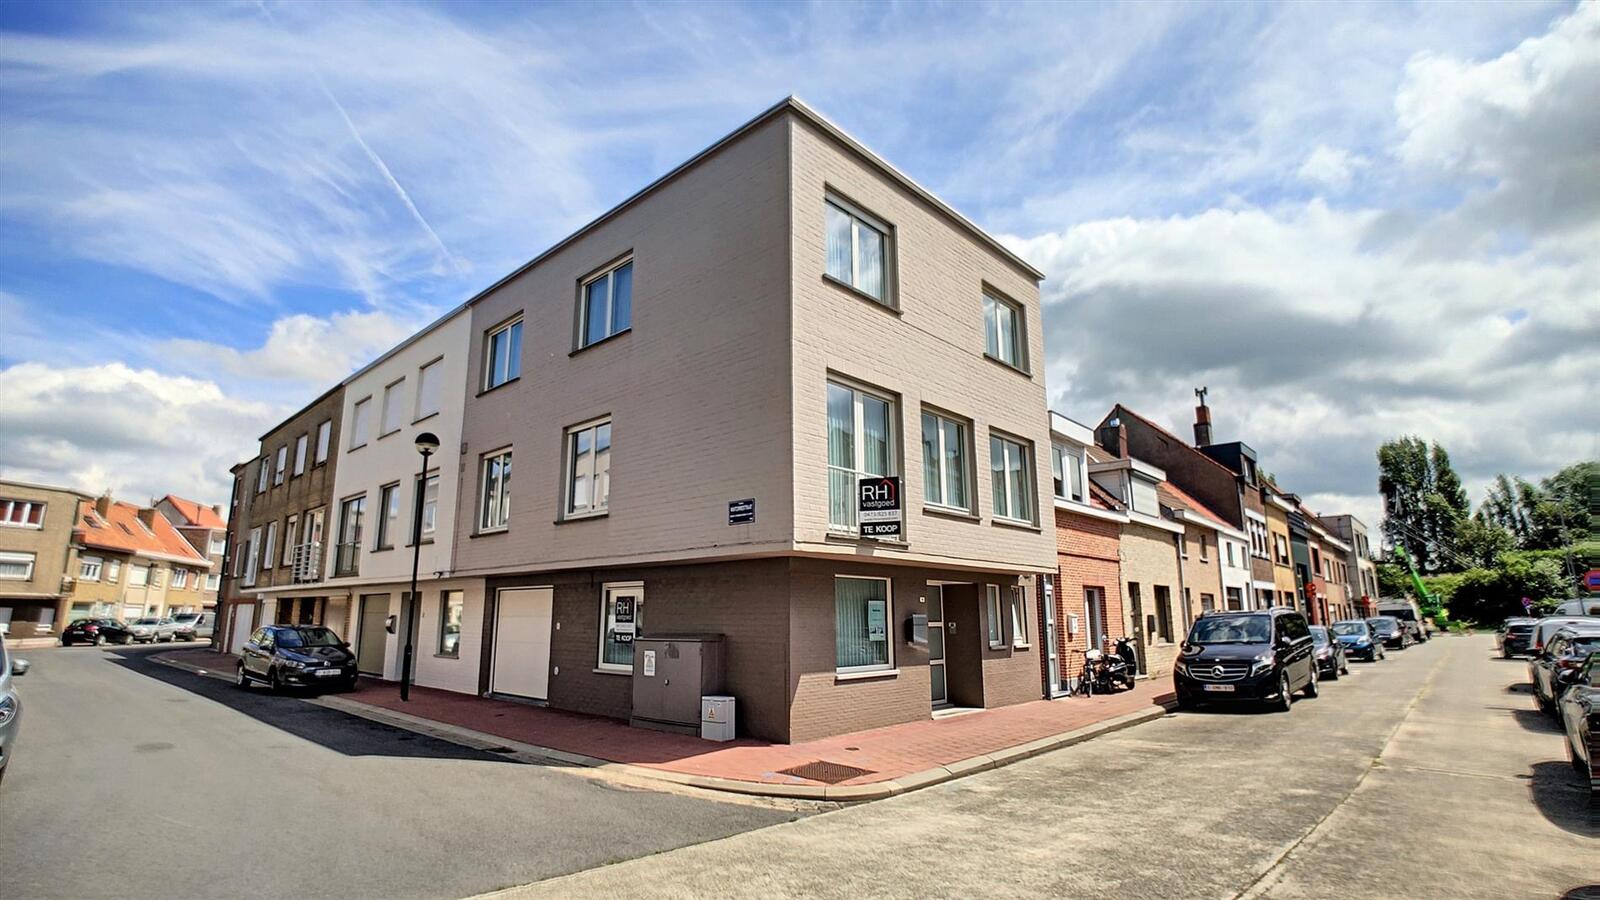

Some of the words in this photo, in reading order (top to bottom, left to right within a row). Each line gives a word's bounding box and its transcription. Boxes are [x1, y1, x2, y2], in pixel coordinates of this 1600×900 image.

[862, 484, 888, 500] RH
[862, 500, 895, 508] vastgoed
[863, 525, 874, 533] TE
[875, 524, 898, 533] KOOP
[617, 602, 629, 614] RH
